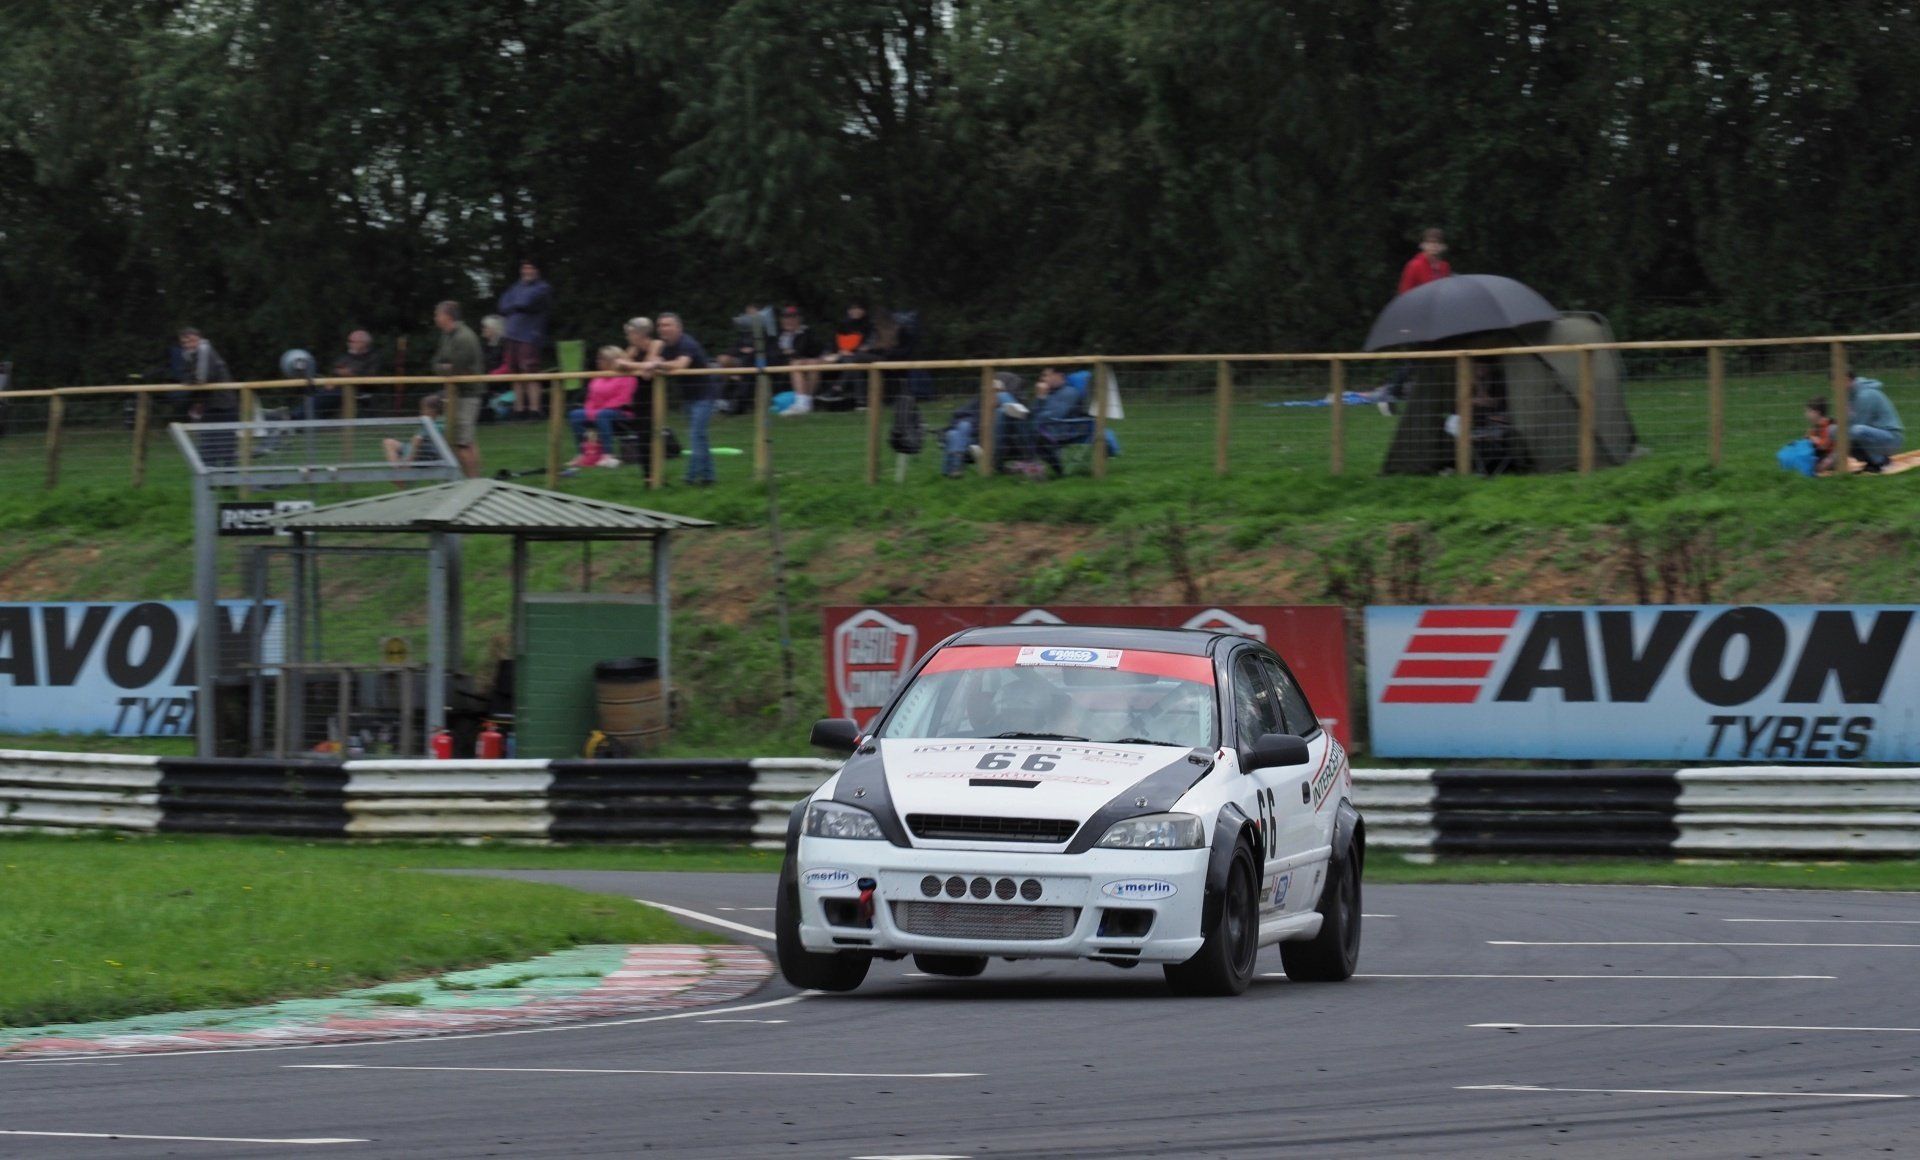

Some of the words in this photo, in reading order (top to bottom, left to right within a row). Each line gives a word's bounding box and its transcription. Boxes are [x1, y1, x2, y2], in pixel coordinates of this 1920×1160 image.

[1496, 606, 1917, 707] AVON
[112, 697, 198, 735] TYR
[1706, 715, 1875, 759] TYRES
[975, 752, 1062, 772] 66
[1256, 786, 1277, 859] 66
[810, 870, 850, 881] merlin
[1125, 882, 1171, 892] merlin
